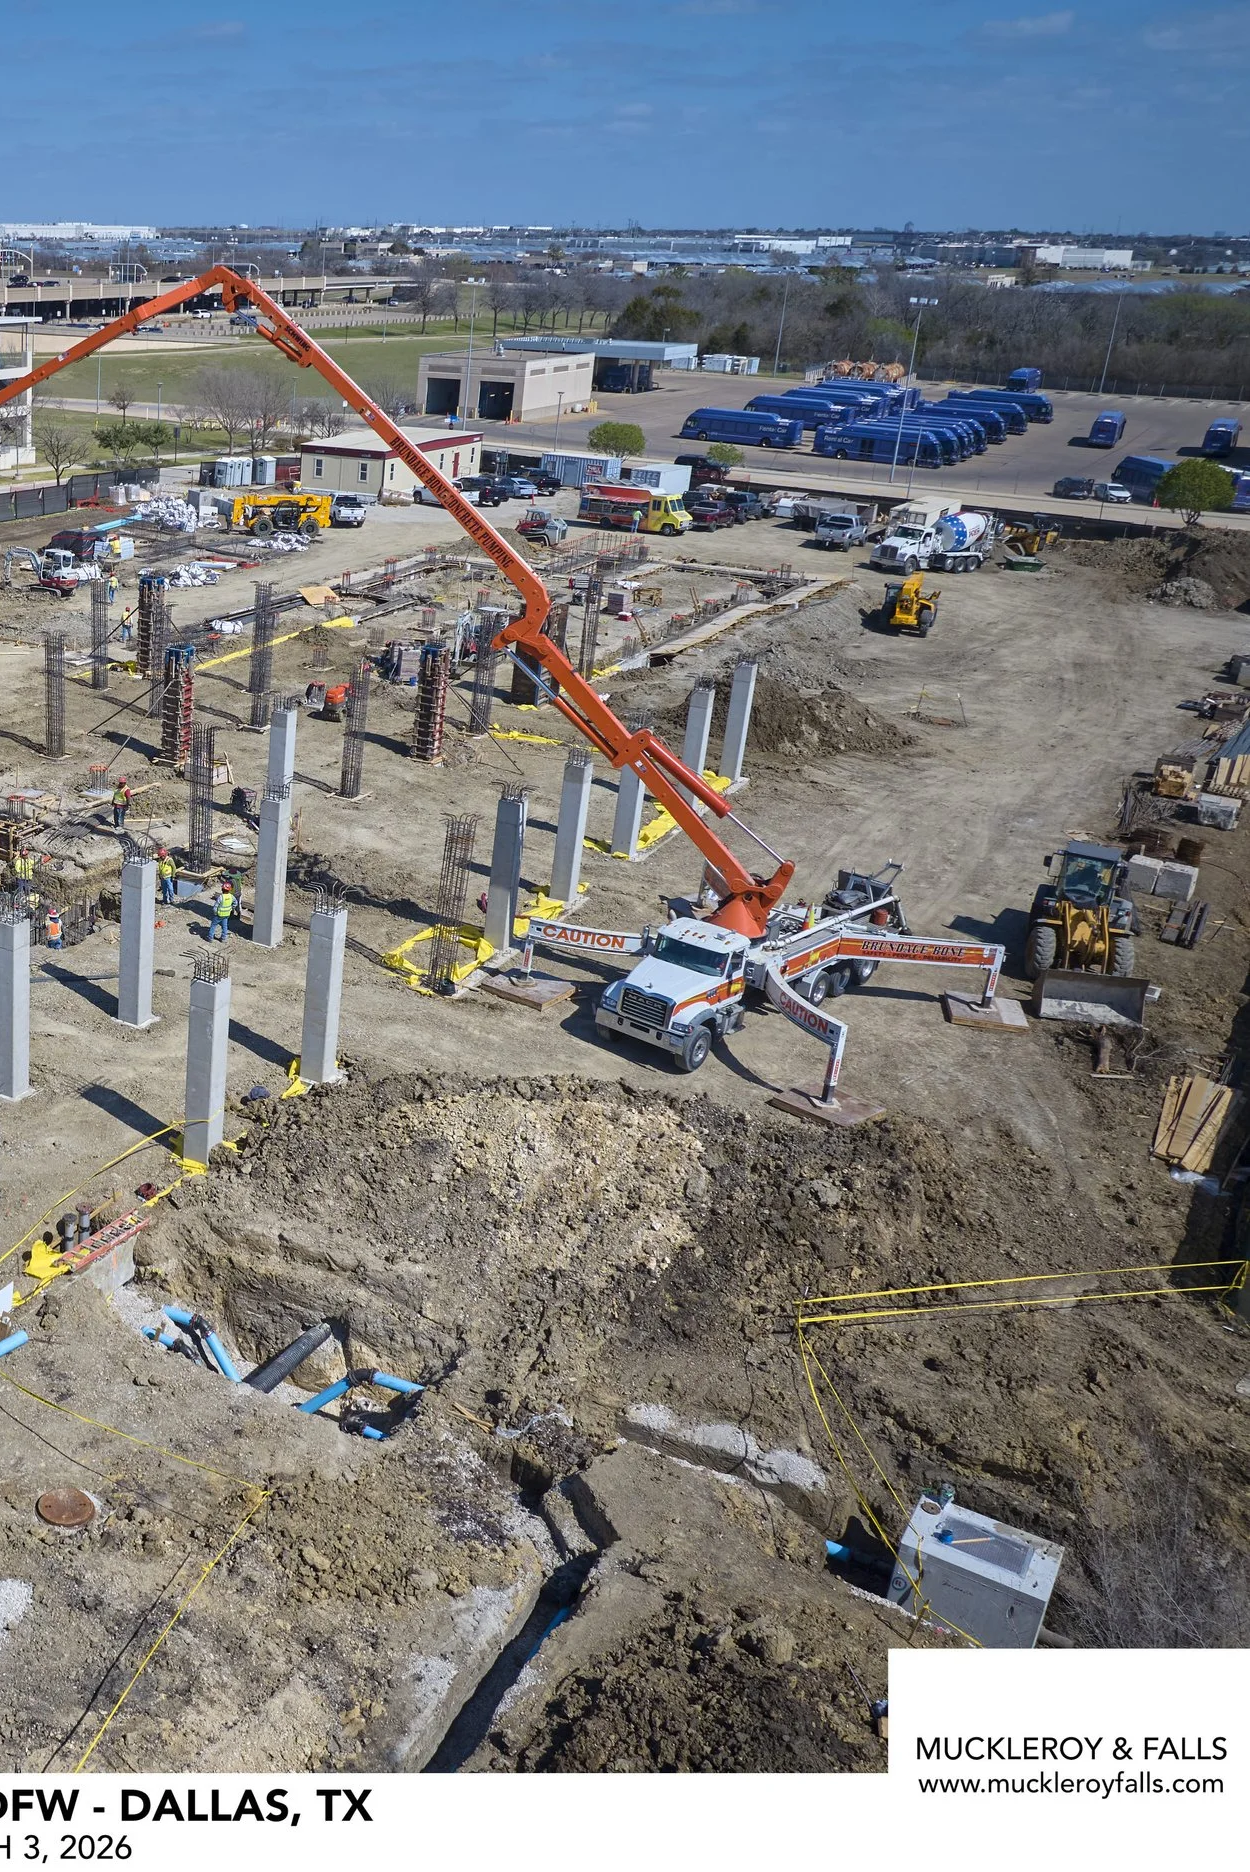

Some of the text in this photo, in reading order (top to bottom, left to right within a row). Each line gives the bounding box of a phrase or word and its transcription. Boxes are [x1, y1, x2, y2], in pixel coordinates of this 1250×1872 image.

[285, 325, 311, 352] SCHWING
[444, 495, 484, 536] CONCRETE
[478, 532, 515, 569] PUMPING
[542, 925, 626, 949] CAUTION
[861, 940, 966, 957] BRUNDAGE BONE
[779, 992, 829, 1035] CAUTION
